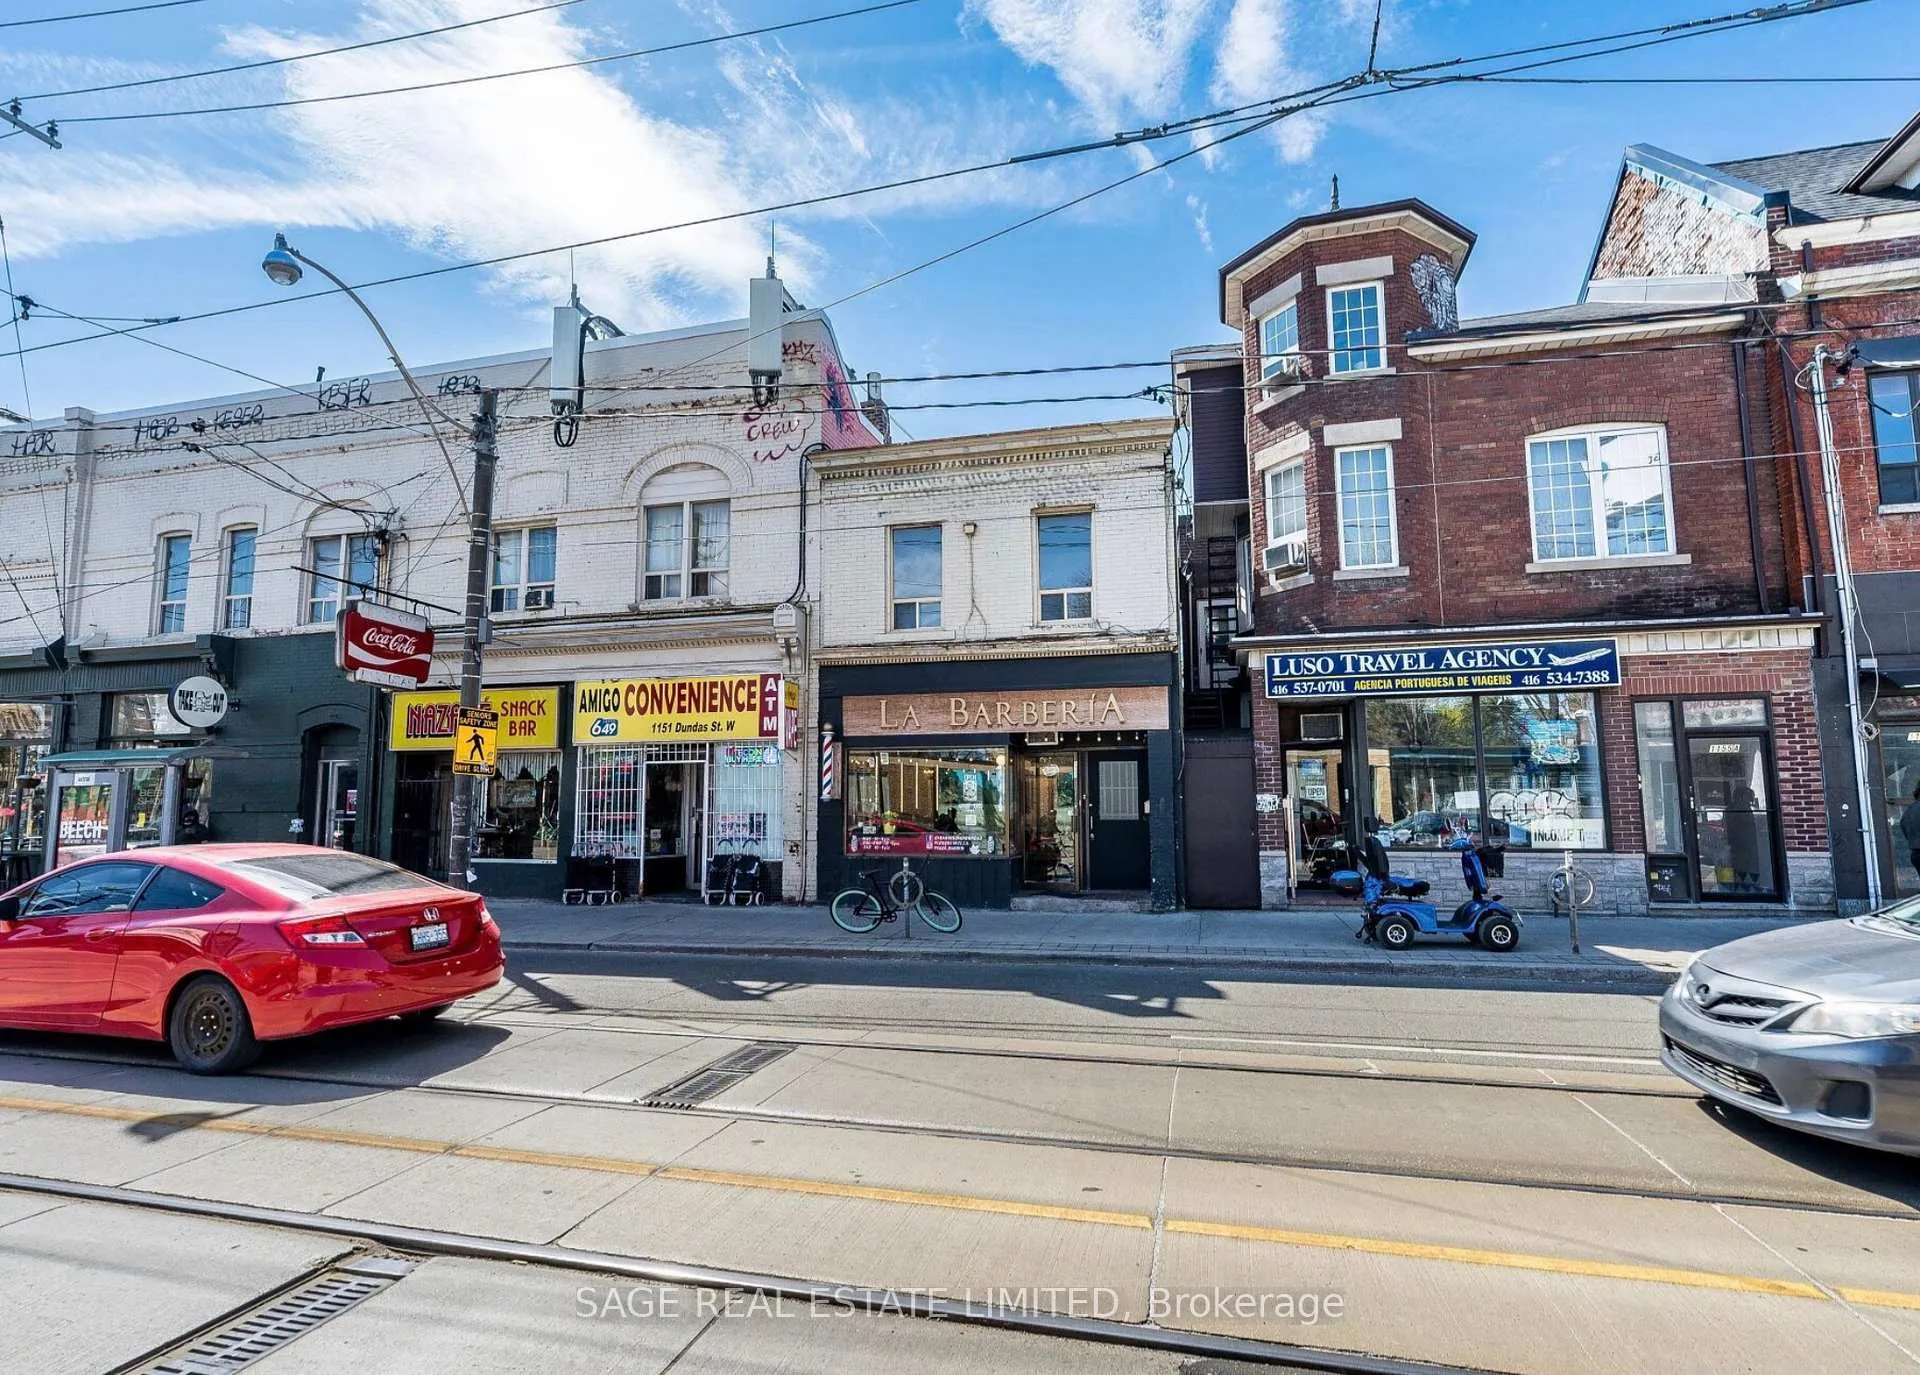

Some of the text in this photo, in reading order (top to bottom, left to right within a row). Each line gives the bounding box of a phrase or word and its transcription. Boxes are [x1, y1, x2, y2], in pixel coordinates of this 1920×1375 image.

[363, 628, 419, 655] Coca-Cola
[1272, 647, 1546, 677] LUSO TRAVEL AGENCY
[1271, 669, 1610, 695] 416 537-0701 AGENCIA PORTUGUESA DE VIAGENS 416 534-7388
[579, 687, 621, 713] AMIGO
[624, 679, 757, 716] CONVENIENCE
[763, 677, 778, 731] ATM
[466, 710, 492, 719] SENIORS
[501, 700, 547, 717] SNACK
[880, 699, 921, 729] LA
[459, 716, 497, 728] SAFETY ZONE
[509, 720, 537, 736] BAR
[652, 720, 736, 733] 1151 Dundas St. W
[1307, 787, 1326, 796] OPEN
